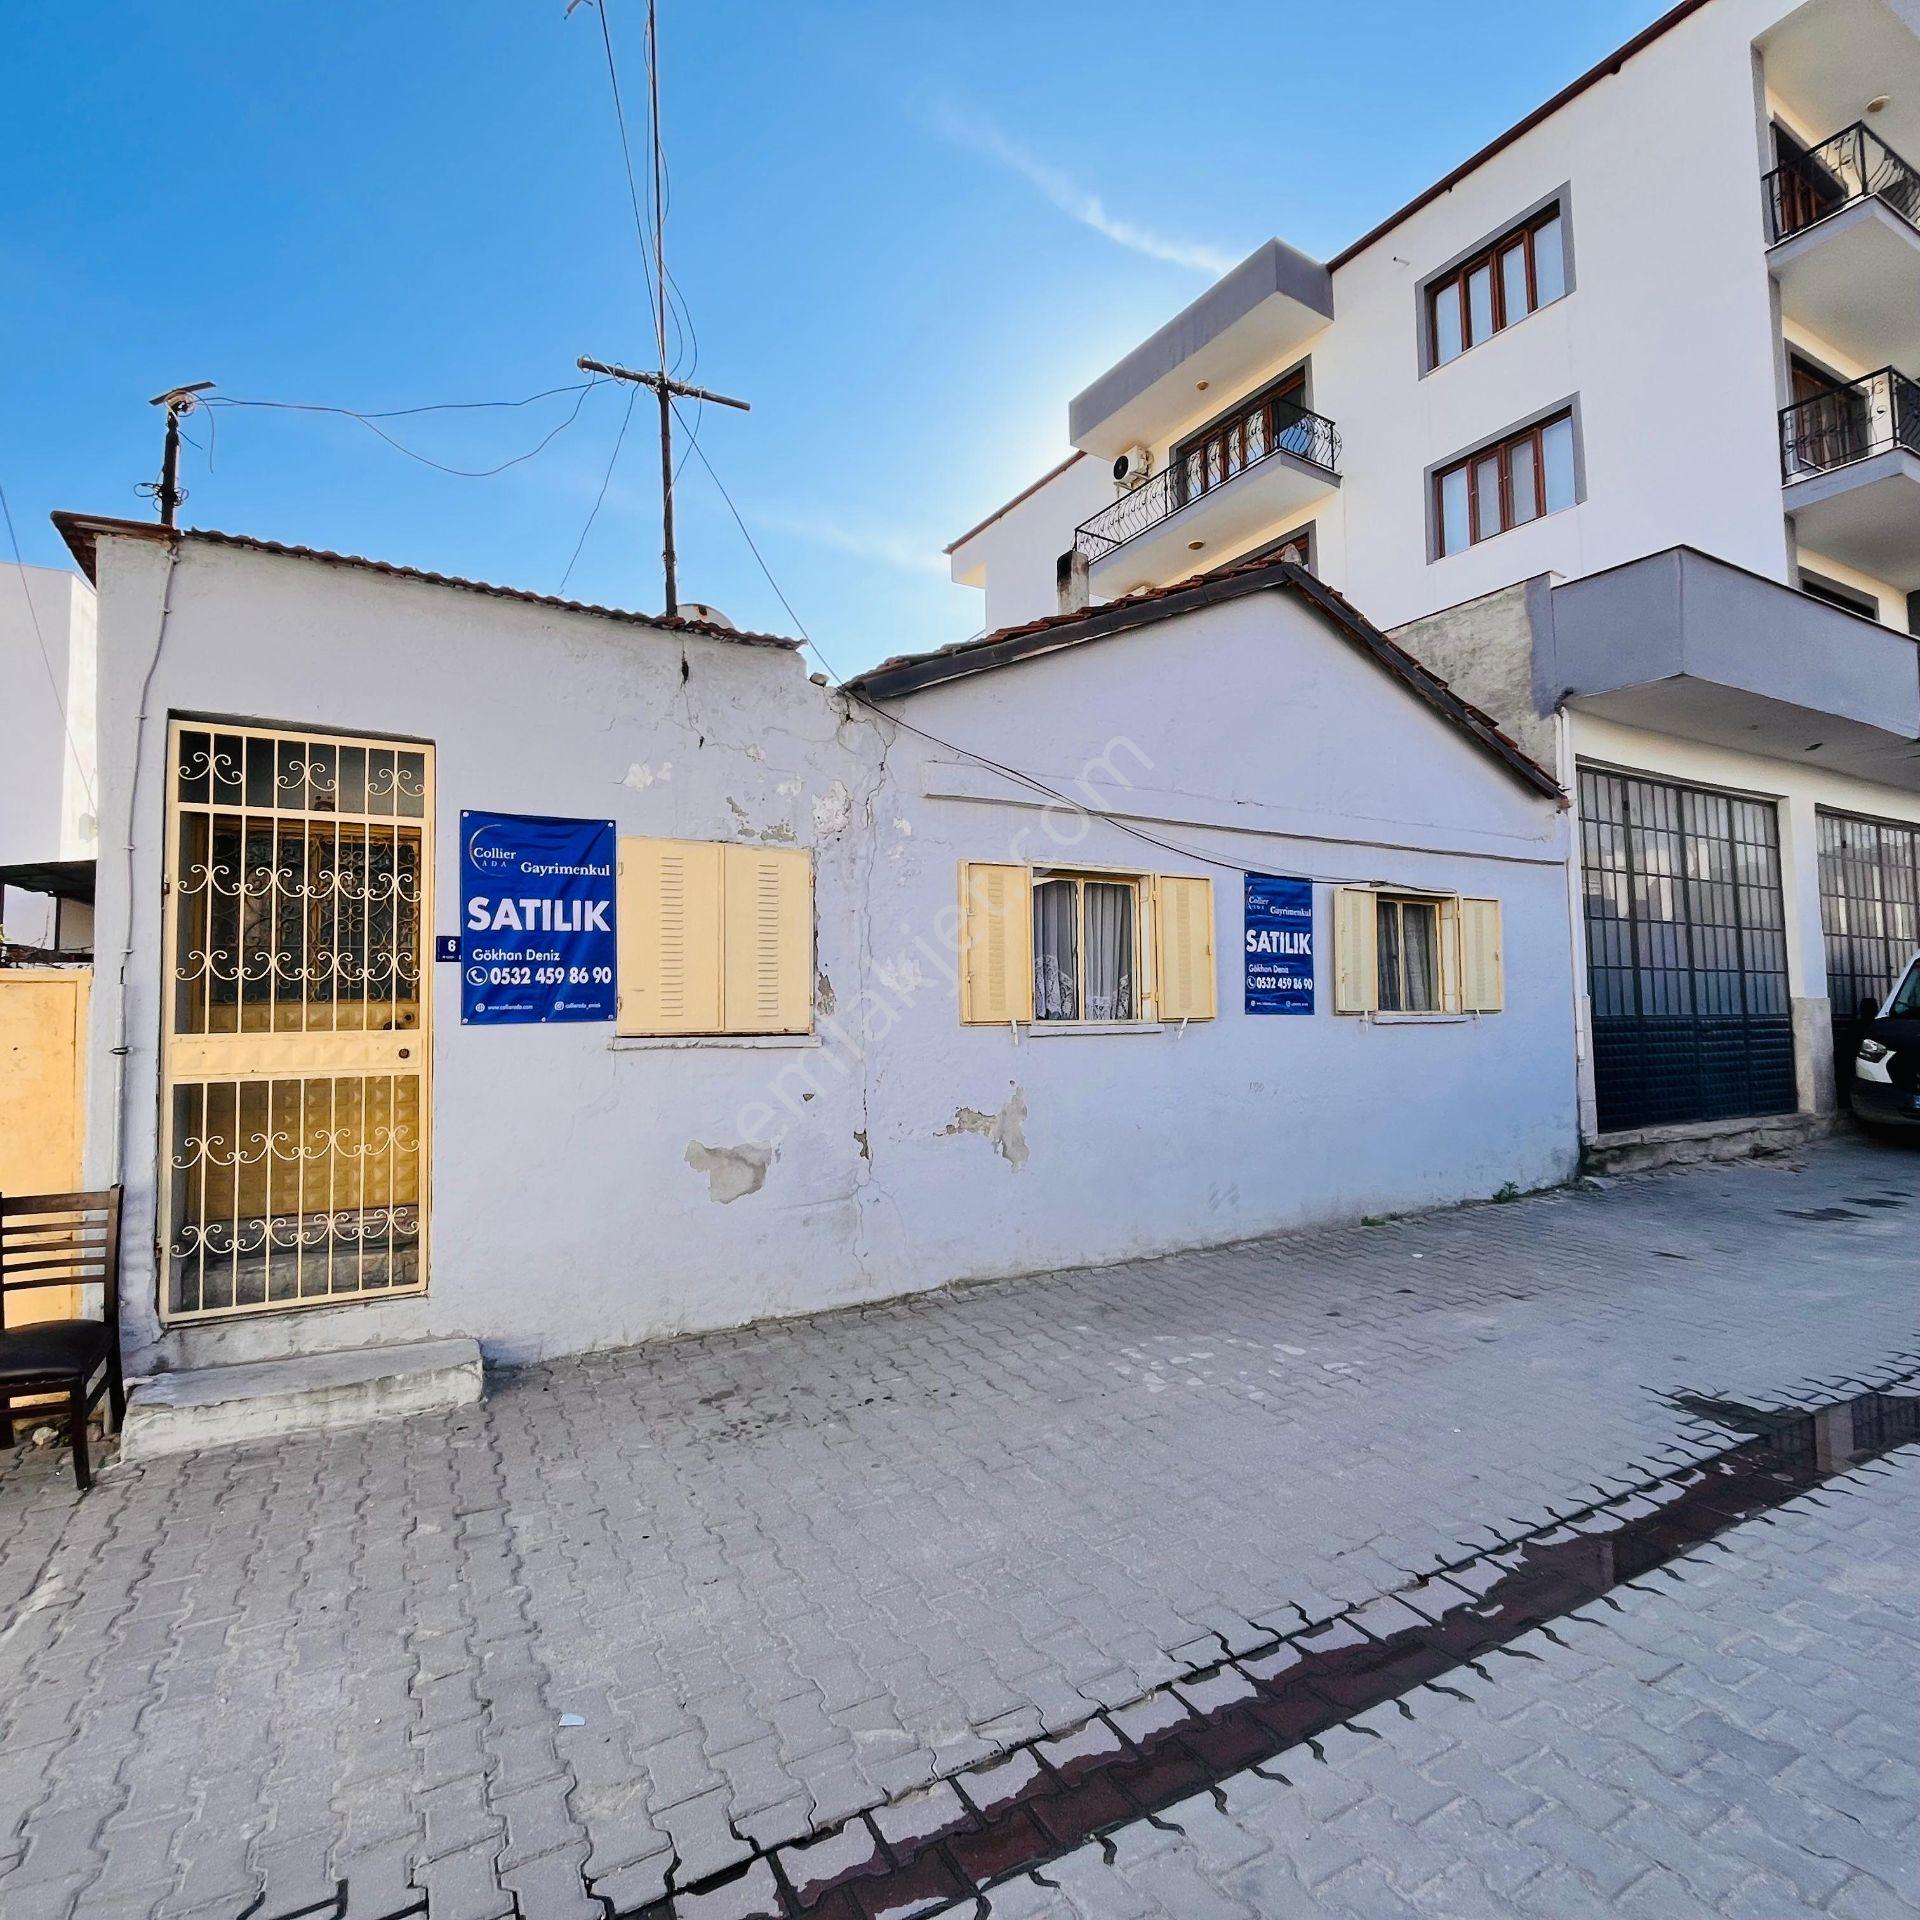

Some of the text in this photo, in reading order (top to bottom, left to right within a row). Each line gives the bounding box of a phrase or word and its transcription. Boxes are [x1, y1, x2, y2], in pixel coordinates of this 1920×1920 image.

[473, 847, 517, 860] Collier
[481, 859, 507, 868] ADA
[520, 861, 610, 876] Gayrimenkul
[467, 896, 611, 932] SATILIK
[1246, 929, 1312, 955] SATILIK
[472, 948, 560, 961] Gökhan Deniz
[489, 967, 612, 985] 0532 459 86 90
[1256, 976, 1276, 989] 0532
[1277, 977, 1292, 990] 459
[1303, 978, 1313, 990] 90
